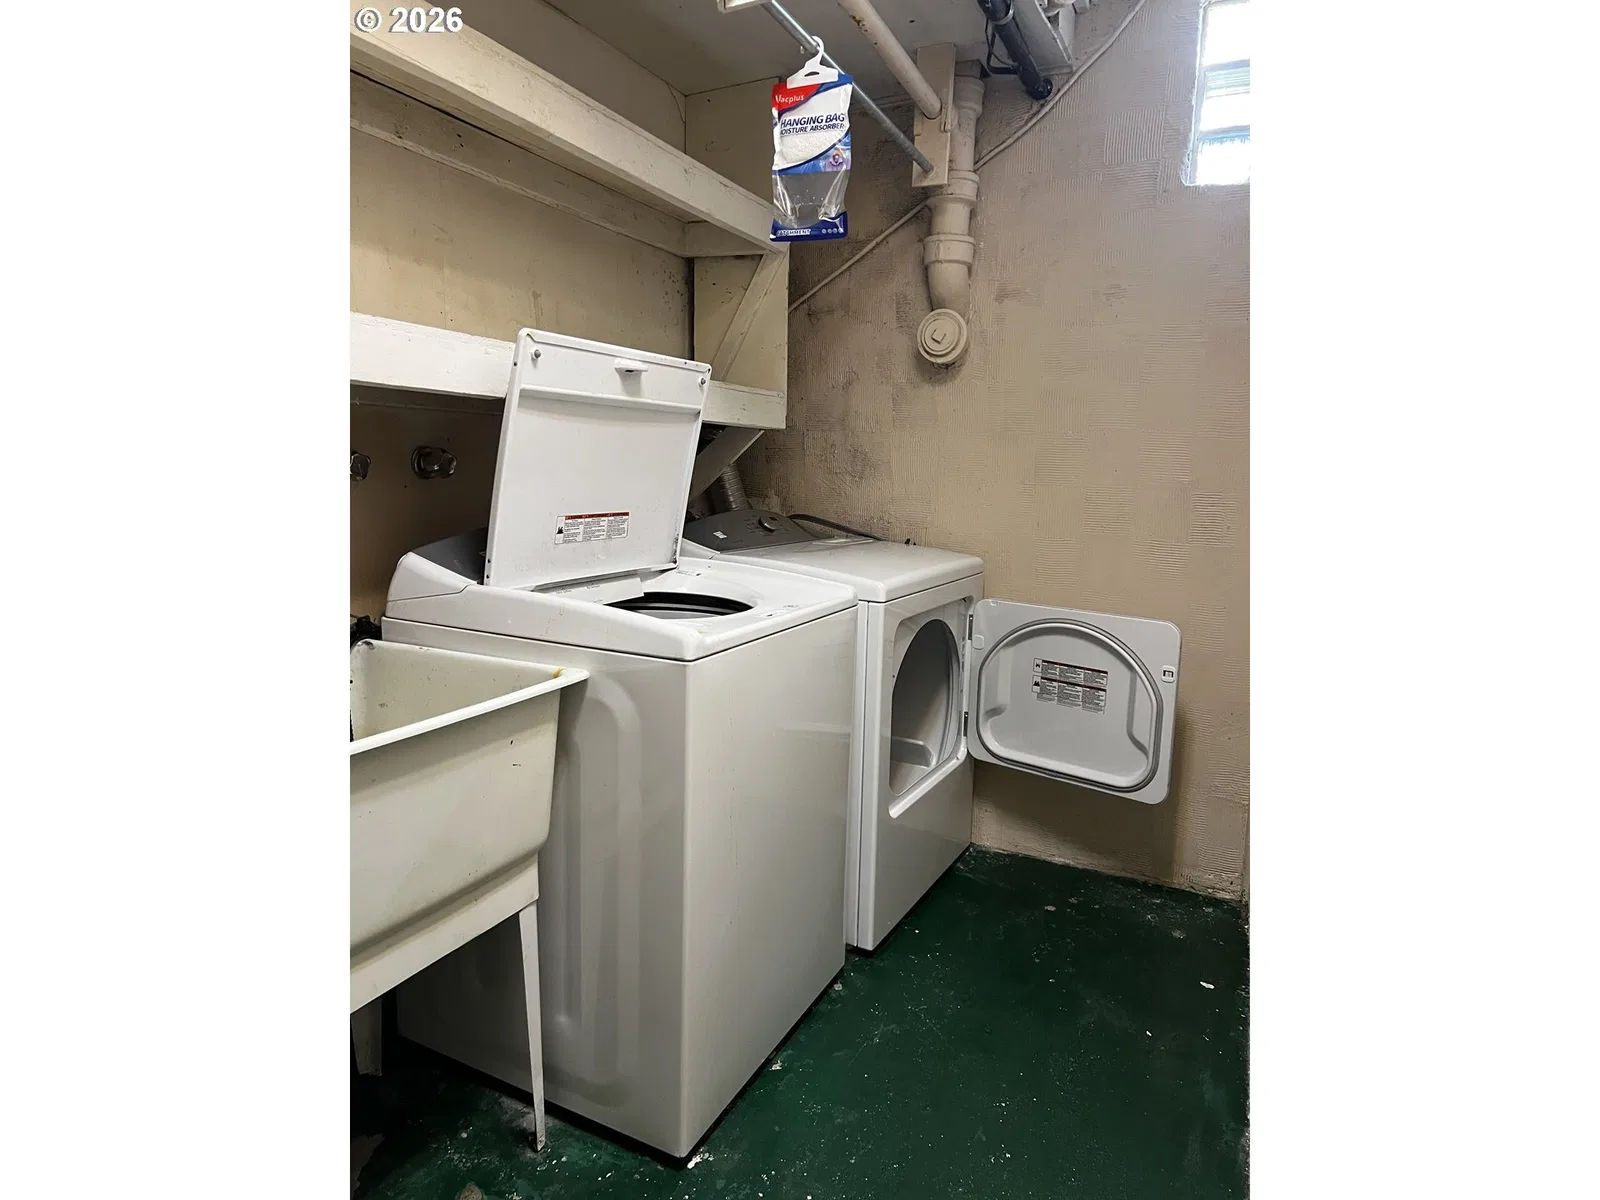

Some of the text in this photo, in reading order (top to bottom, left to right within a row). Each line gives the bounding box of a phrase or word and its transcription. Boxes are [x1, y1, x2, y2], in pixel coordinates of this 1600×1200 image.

[775, 94, 804, 104] Vacplus
[780, 112, 845, 129] HANGING BAG
[780, 122, 845, 136] OISTURE ABSORBER
